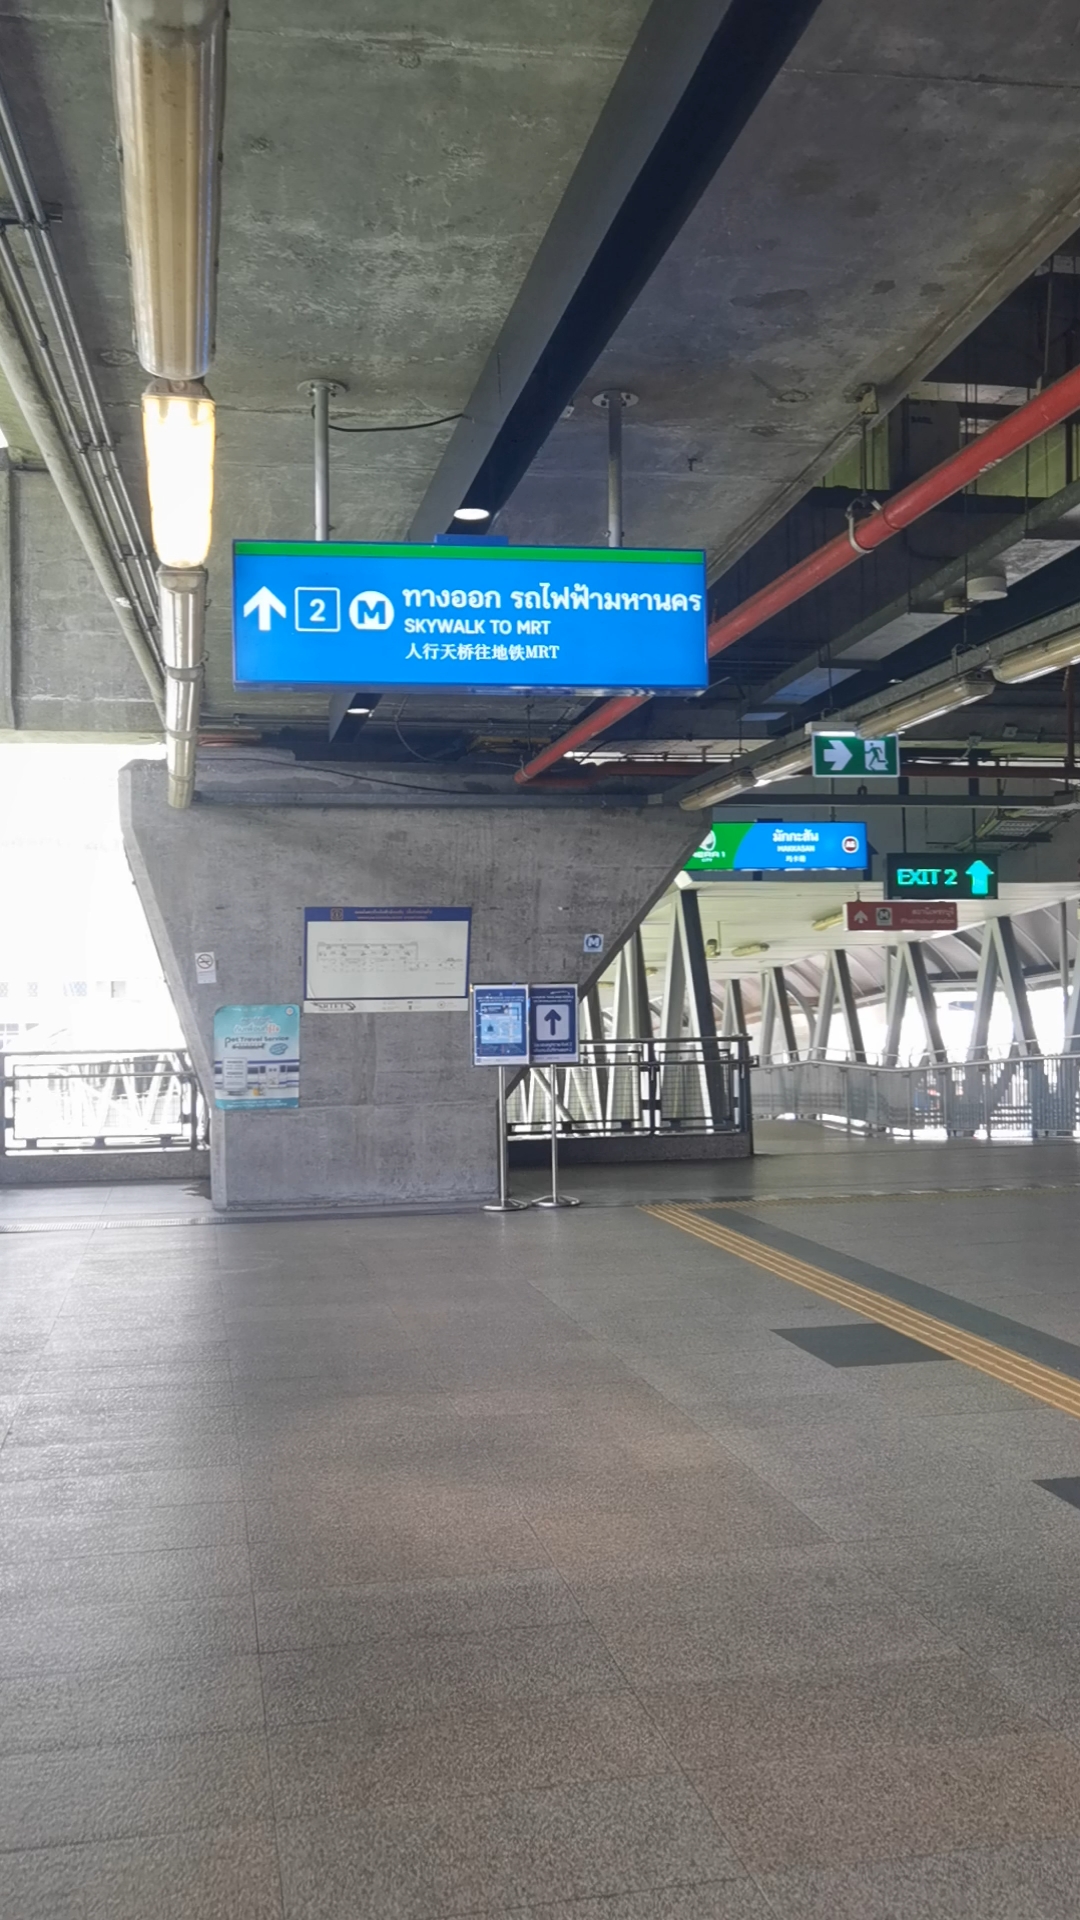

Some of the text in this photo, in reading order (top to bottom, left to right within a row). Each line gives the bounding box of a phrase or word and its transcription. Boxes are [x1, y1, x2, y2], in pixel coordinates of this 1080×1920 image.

[402, 582, 702, 612] ทางออก รถไฟฟ้ามหานคร
[309, 598, 326, 622] 2
[404, 618, 551, 636] SKYWALK TO MRT
[405, 642, 559, 662] 人行天桥往地铁MRT
[897, 868, 958, 885] EXIT 2
